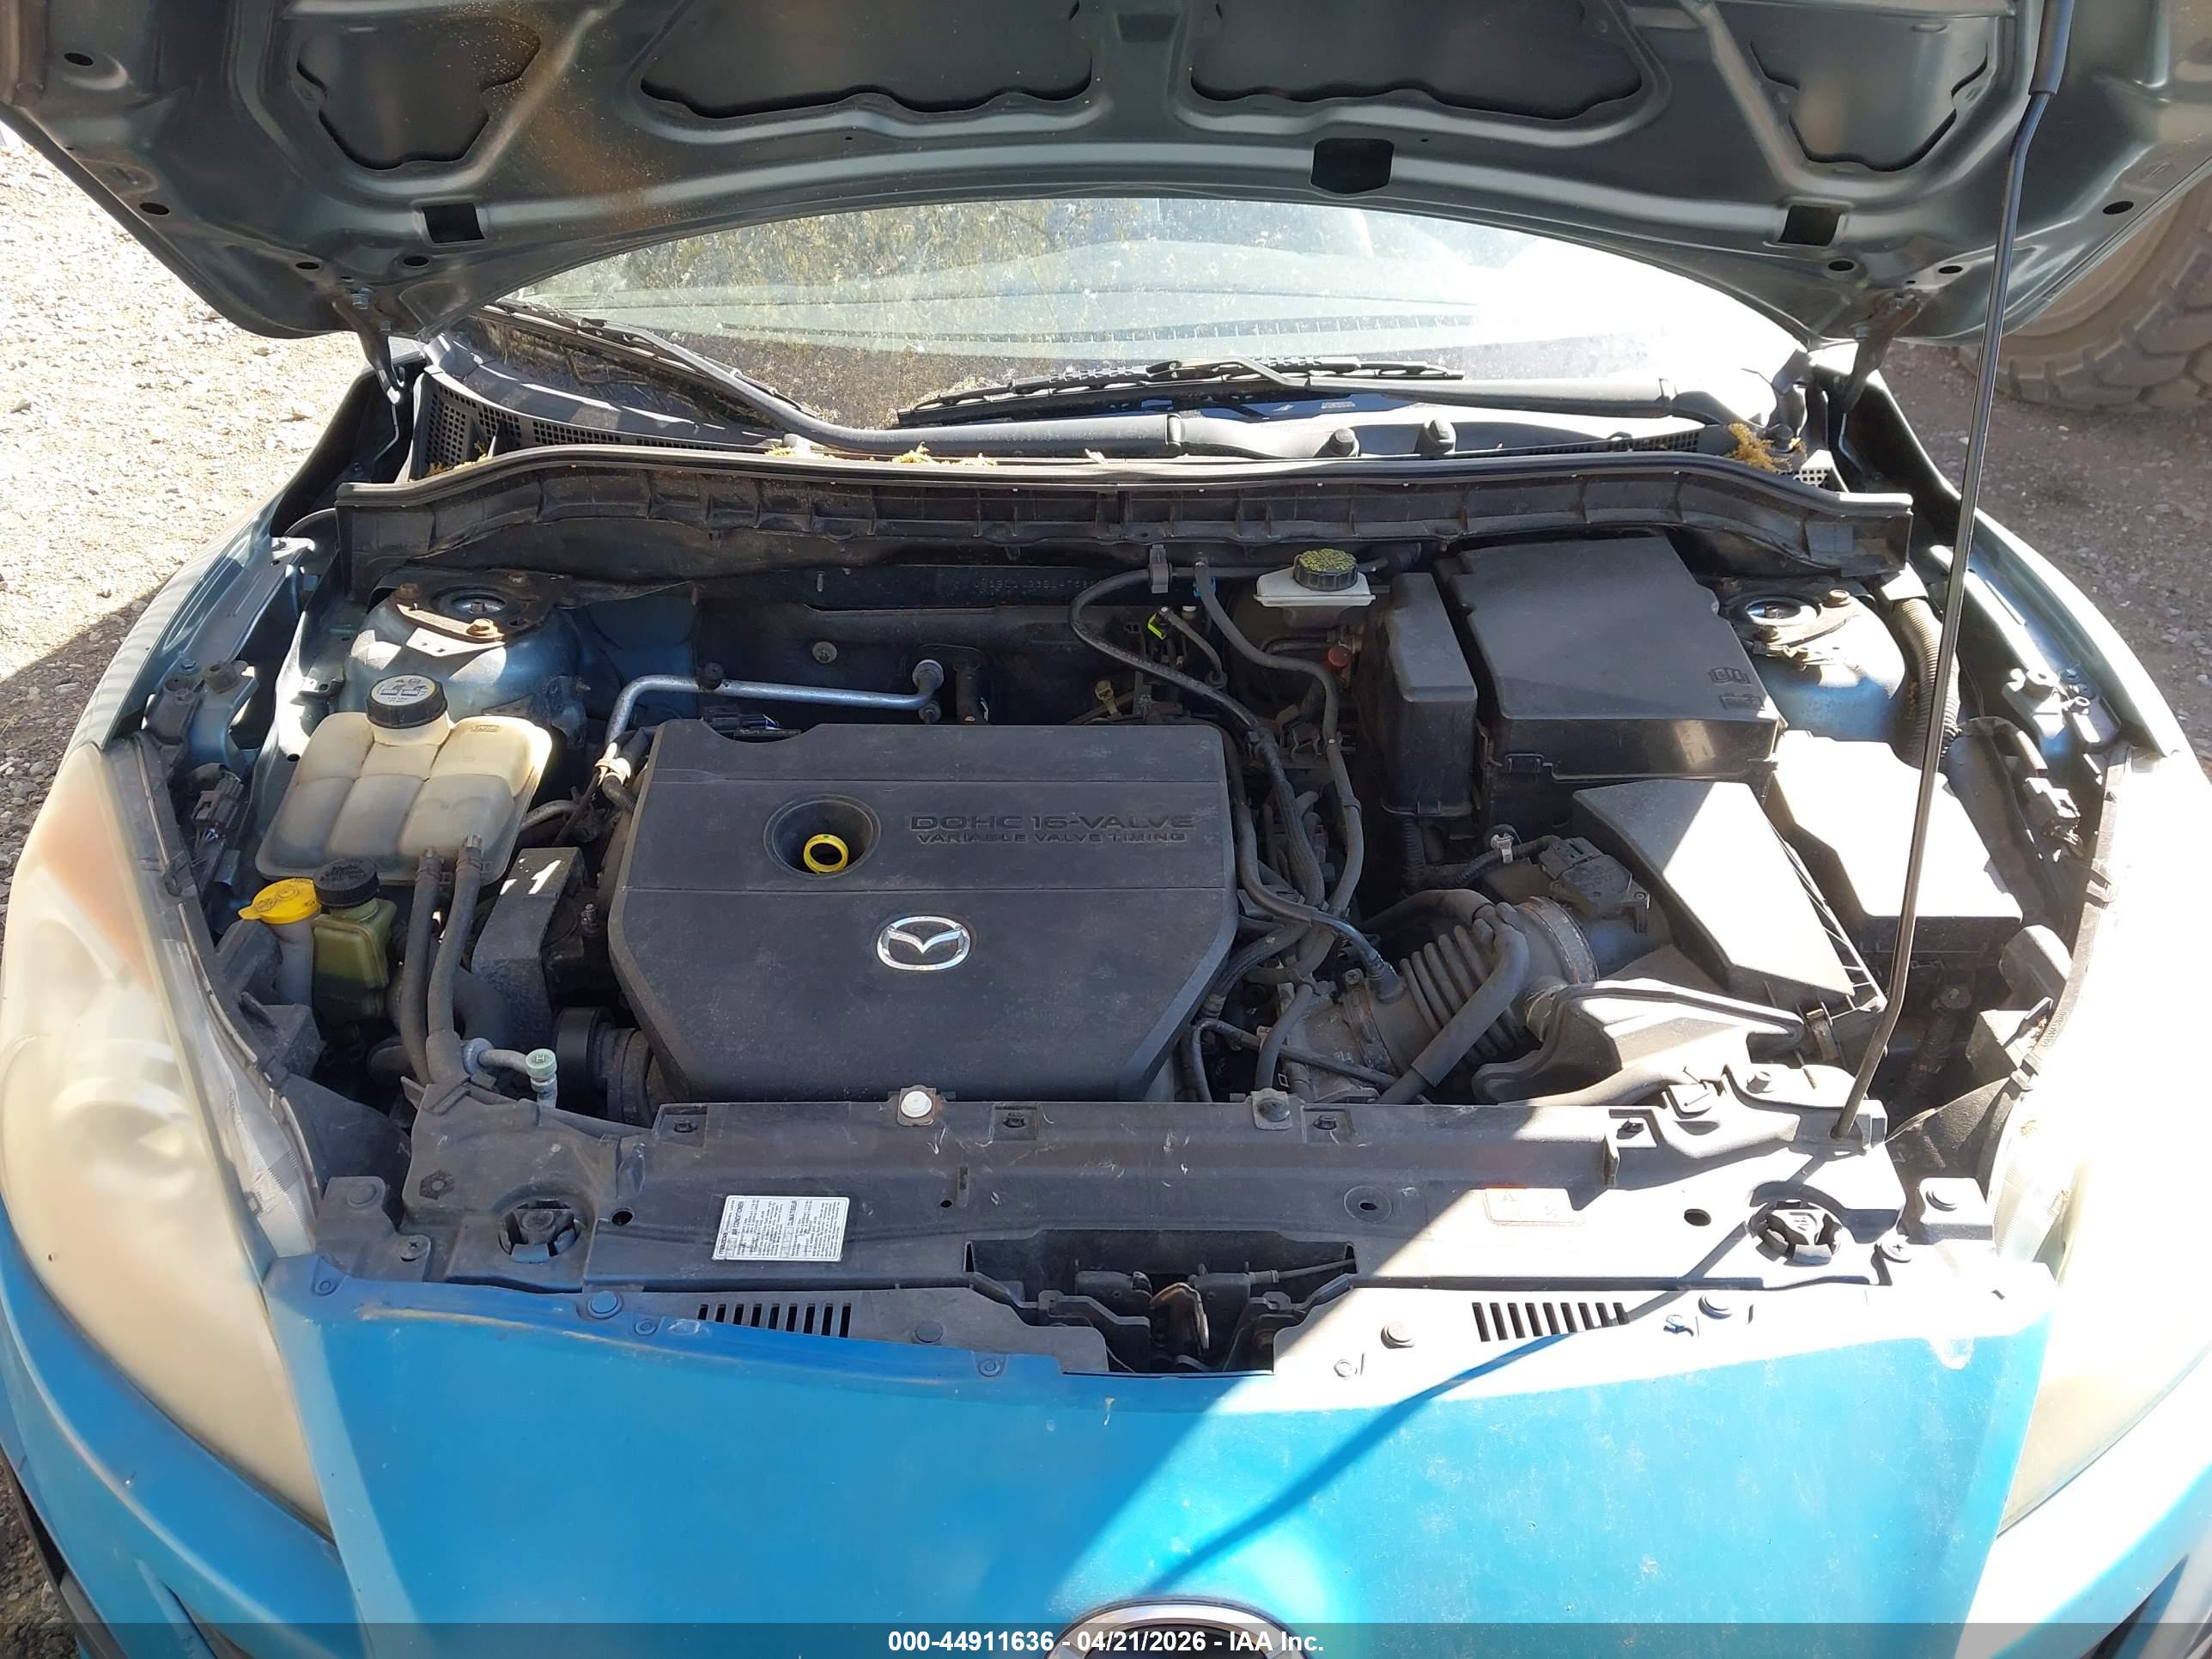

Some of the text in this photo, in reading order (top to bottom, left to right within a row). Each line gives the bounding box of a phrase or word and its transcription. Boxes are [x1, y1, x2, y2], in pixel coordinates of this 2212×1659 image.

[910, 816, 1195, 830] DOHC 16-VALVE
[917, 832, 1187, 844] VARIABLE VALVE TIMING
[536, 1054, 545, 1063] H
